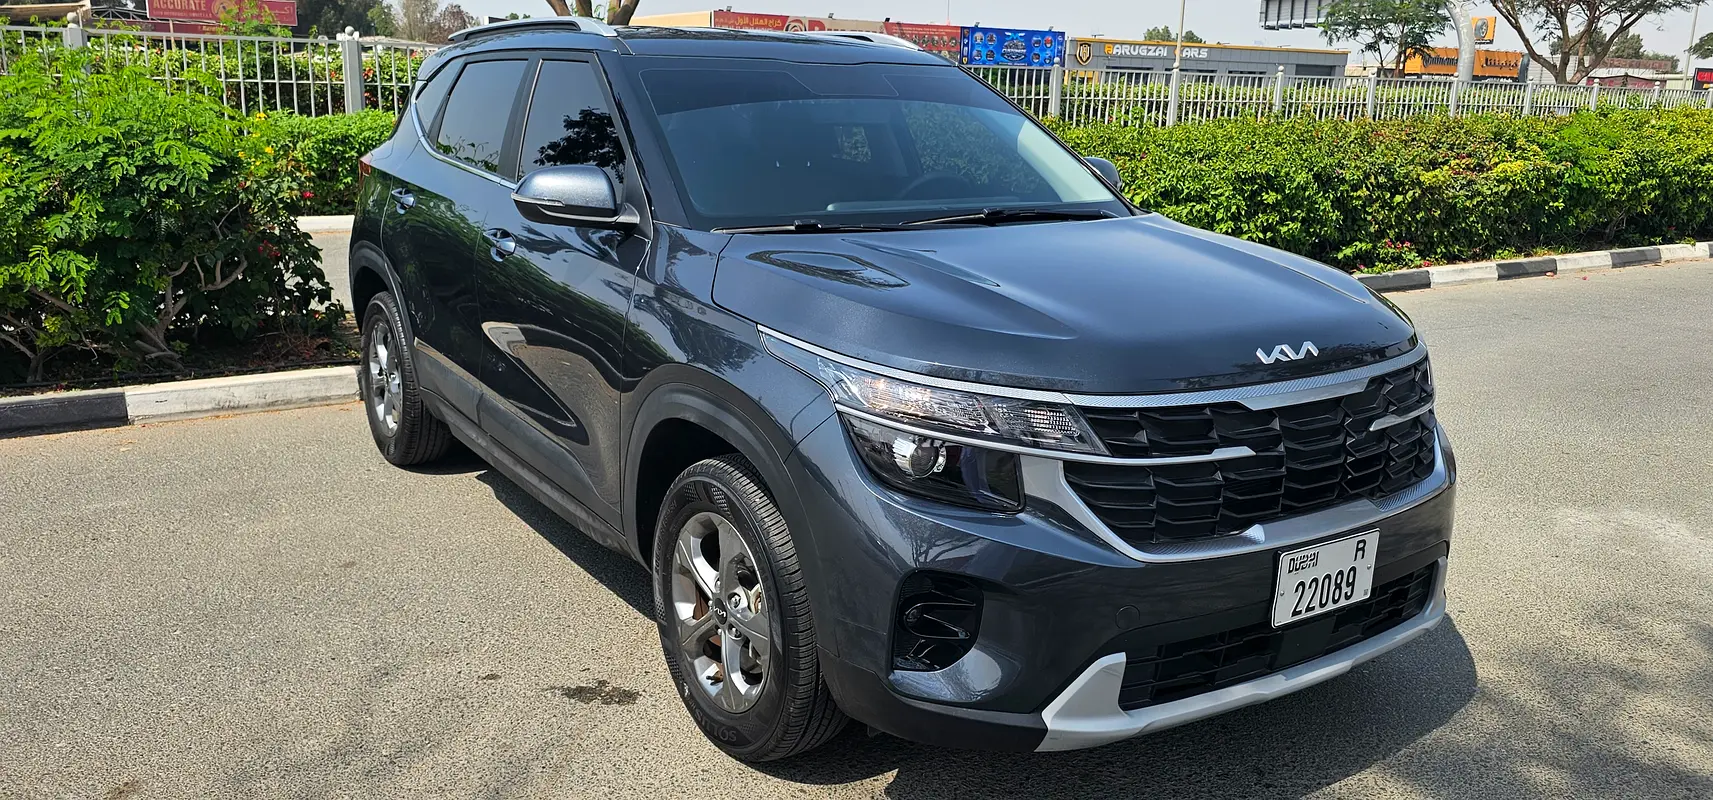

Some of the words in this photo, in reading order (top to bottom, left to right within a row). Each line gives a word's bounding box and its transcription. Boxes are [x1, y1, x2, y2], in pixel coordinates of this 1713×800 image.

[153, 0, 206, 11] ACCURATE
[1104, 43, 1168, 57] BARUGZAI
[1255, 340, 1319, 365] KIA
[1353, 538, 1367, 562] R
[1291, 565, 1357, 618] 22089
